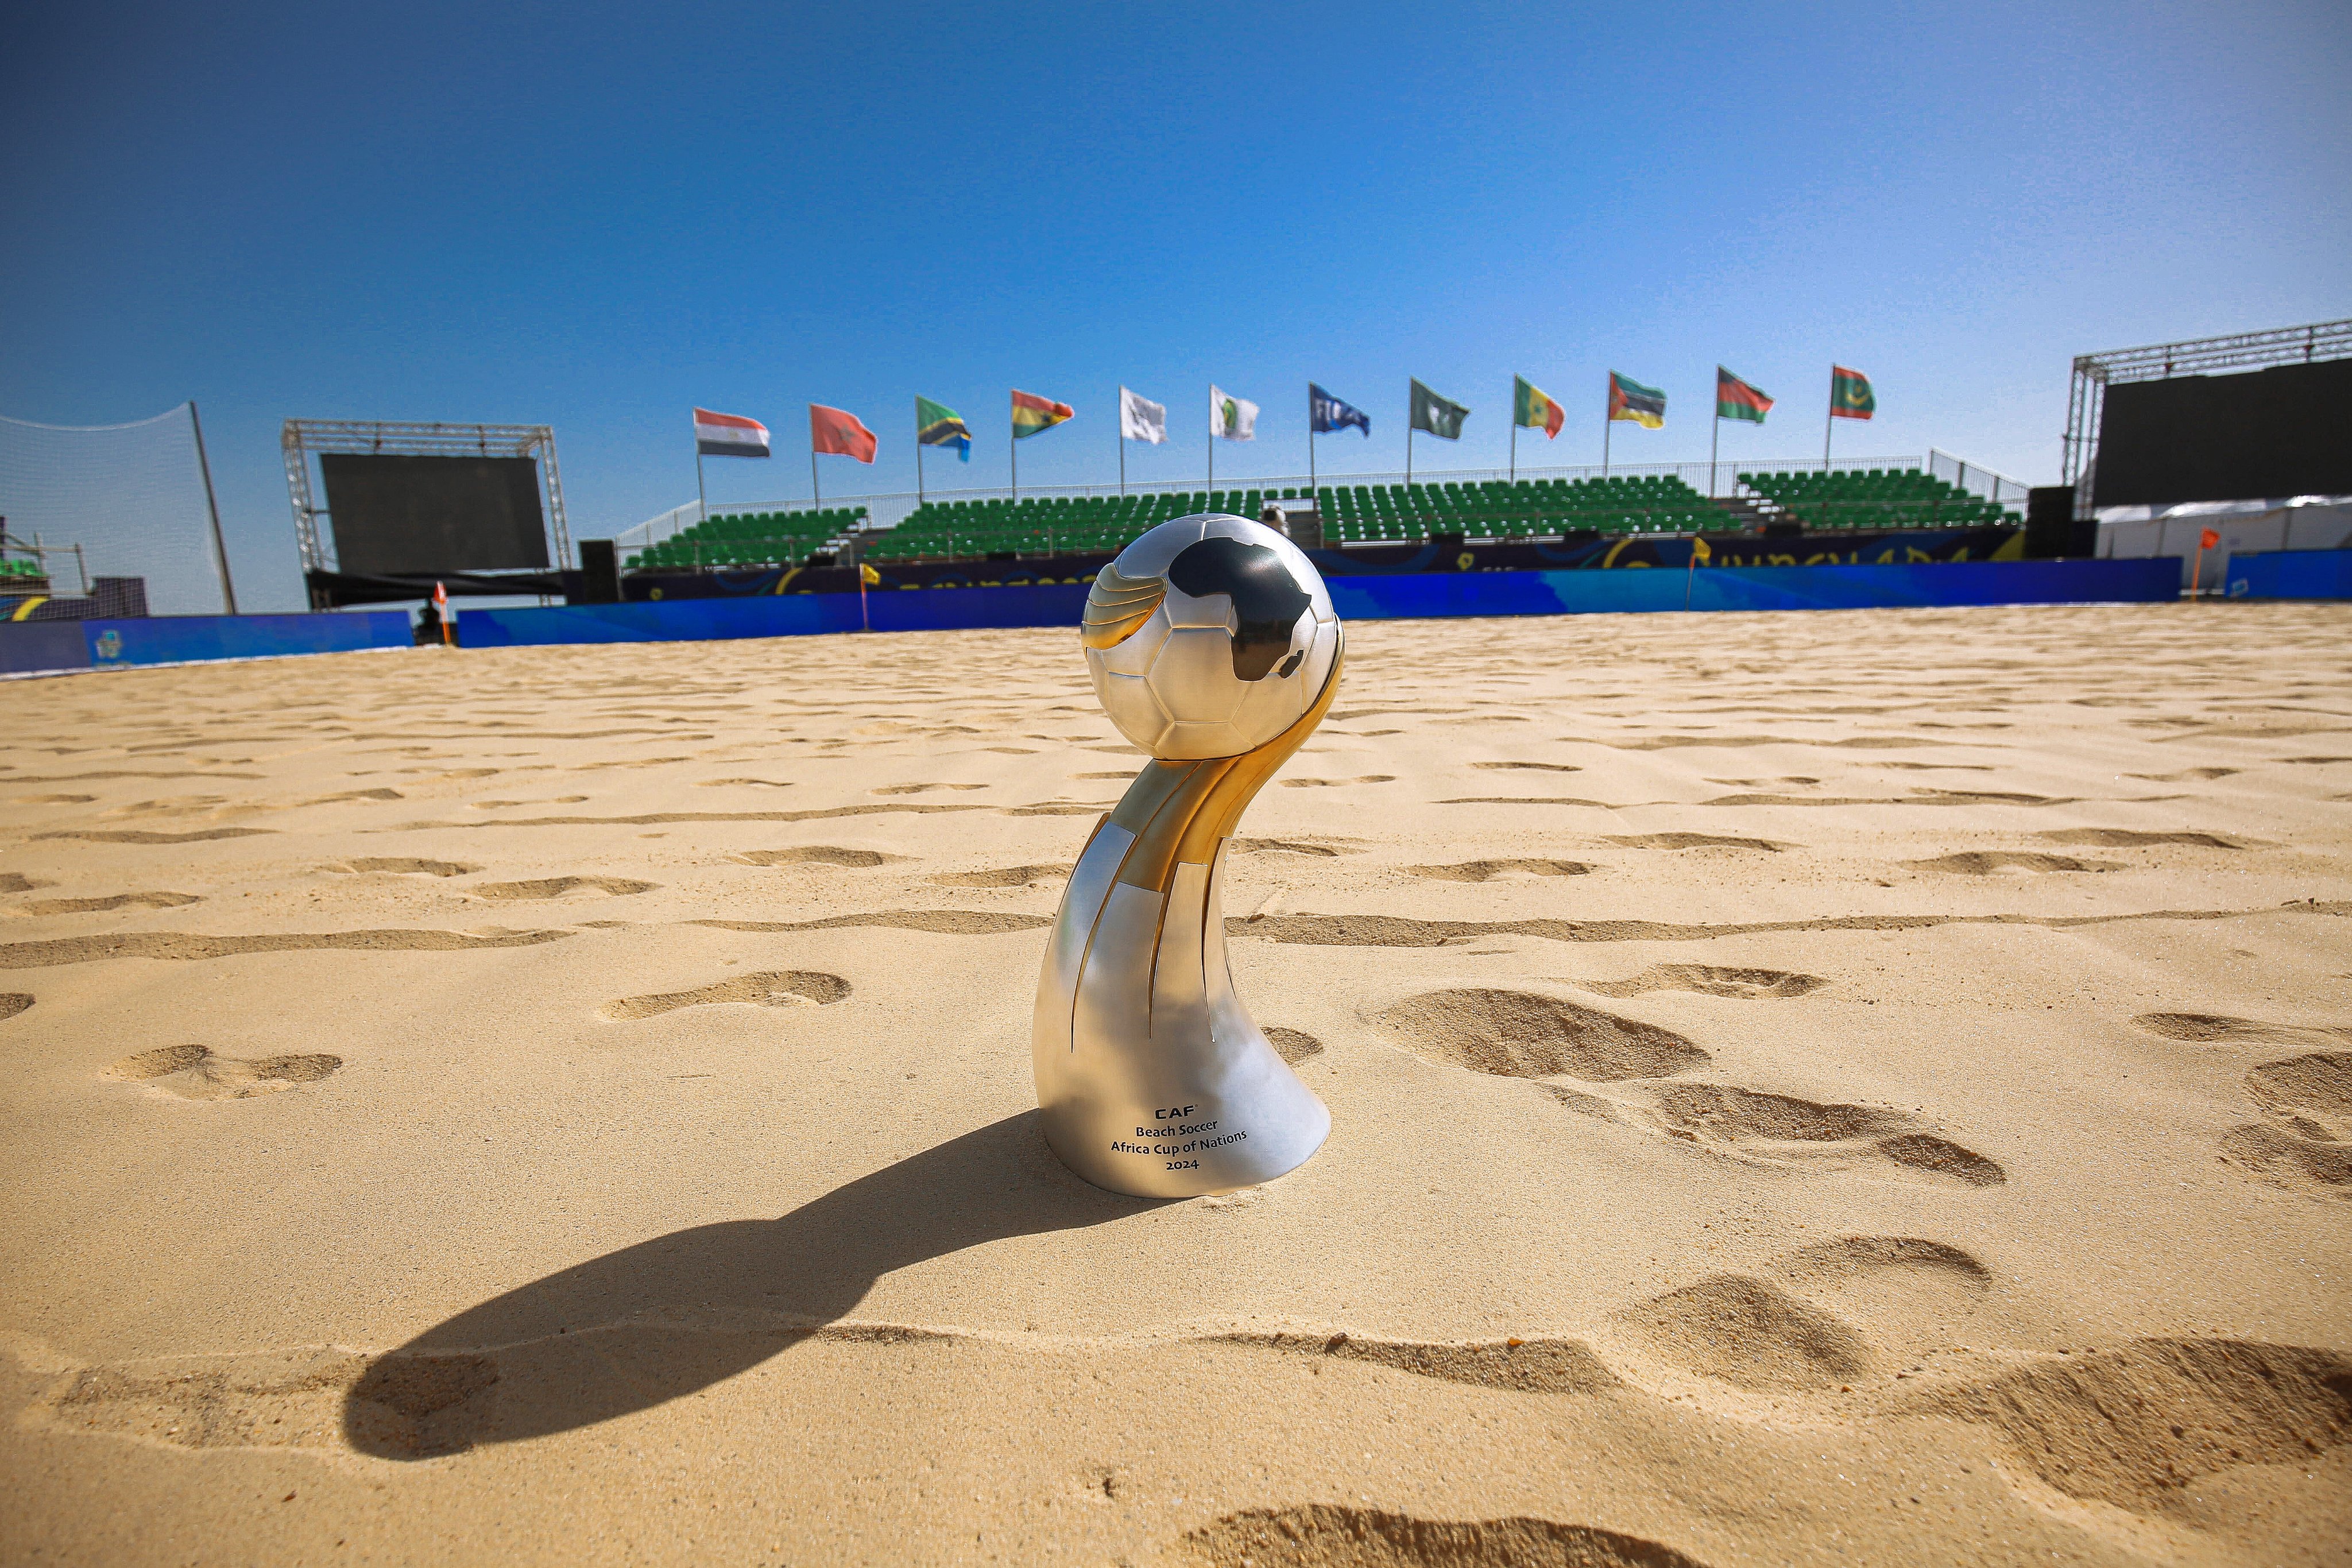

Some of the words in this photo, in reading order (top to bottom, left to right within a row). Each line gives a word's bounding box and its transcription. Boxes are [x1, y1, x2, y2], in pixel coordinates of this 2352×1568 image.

[1155, 1105, 1194, 1120] CAF
[1136, 1125, 1176, 1137] Beach
[1179, 1120, 1218, 1136] Soccer
[1111, 1141, 1150, 1155] Africa
[1154, 1144, 1179, 1157] Cup
[1183, 1140, 1196, 1153] of
[1200, 1130, 1247, 1151] Nations
[1166, 1159, 1200, 1170] 2024
